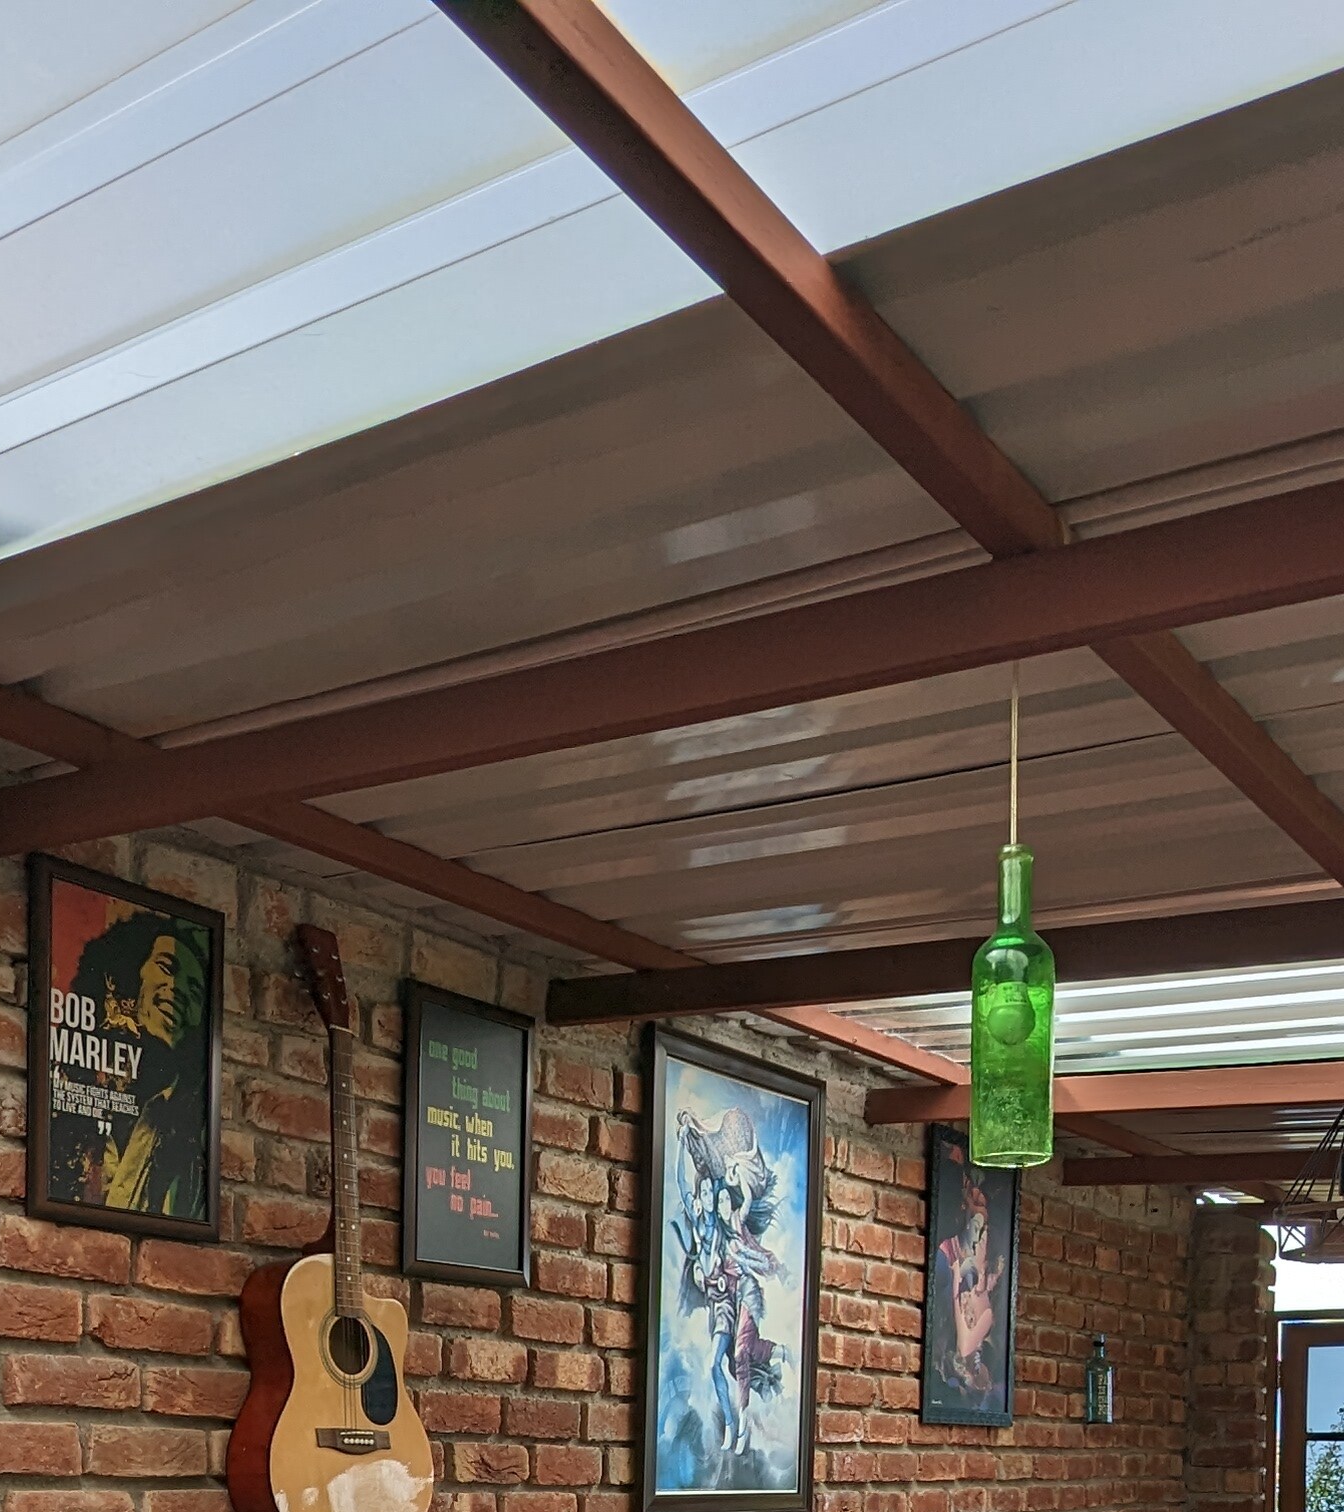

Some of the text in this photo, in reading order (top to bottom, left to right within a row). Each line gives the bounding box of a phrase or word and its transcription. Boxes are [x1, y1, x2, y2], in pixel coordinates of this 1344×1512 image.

[50, 987, 96, 1032] BOB
[49, 1025, 143, 1080] MARLEY
[429, 1040, 478, 1070] one good
[53, 1088, 66, 1101] THE
[66, 1091, 93, 1106] SYSTEM
[62, 1100, 77, 1114] LIVE
[452, 1075, 510, 1113] thing about
[465, 1112, 494, 1138] when
[451, 1134, 460, 1158] it
[467, 1137, 488, 1163] hits
[425, 1165, 471, 1191] you feel
[450, 1194, 464, 1213] no
